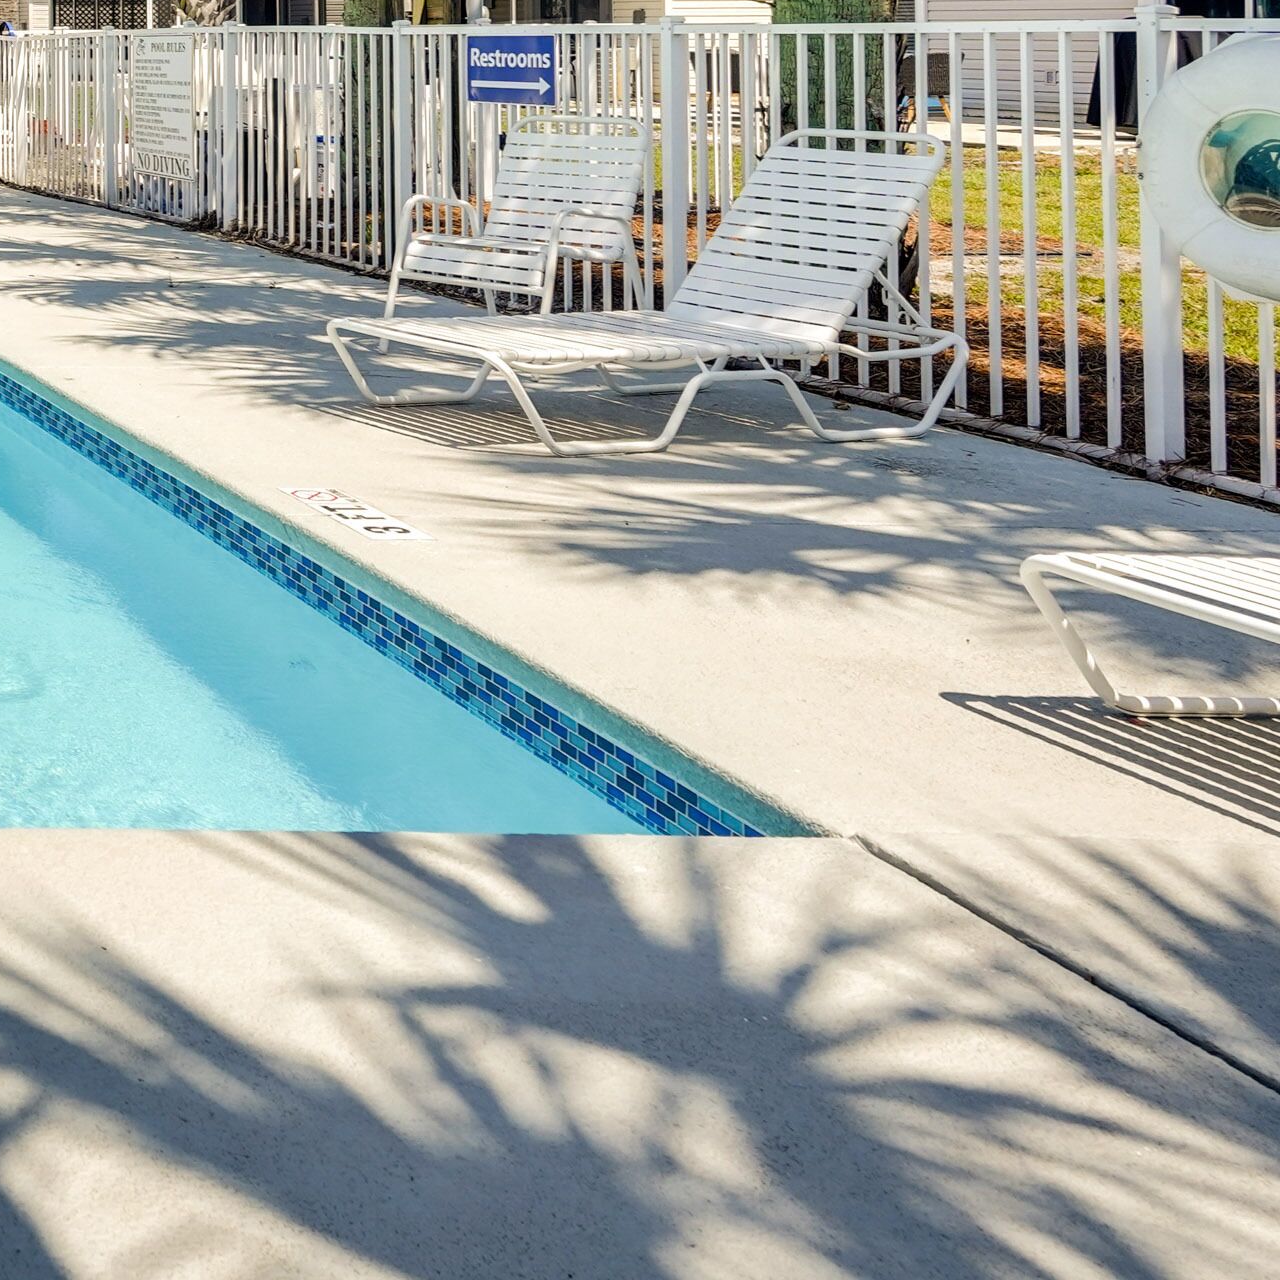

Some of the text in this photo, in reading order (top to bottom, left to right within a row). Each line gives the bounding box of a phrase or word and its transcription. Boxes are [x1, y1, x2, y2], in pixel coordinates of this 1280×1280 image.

[151, 42, 186, 52] POOL RULES
[470, 47, 551, 68] Restrooms
[137, 152, 150, 170] NO
[153, 154, 189, 177] DIVING
[363, 525, 411, 534] 3
